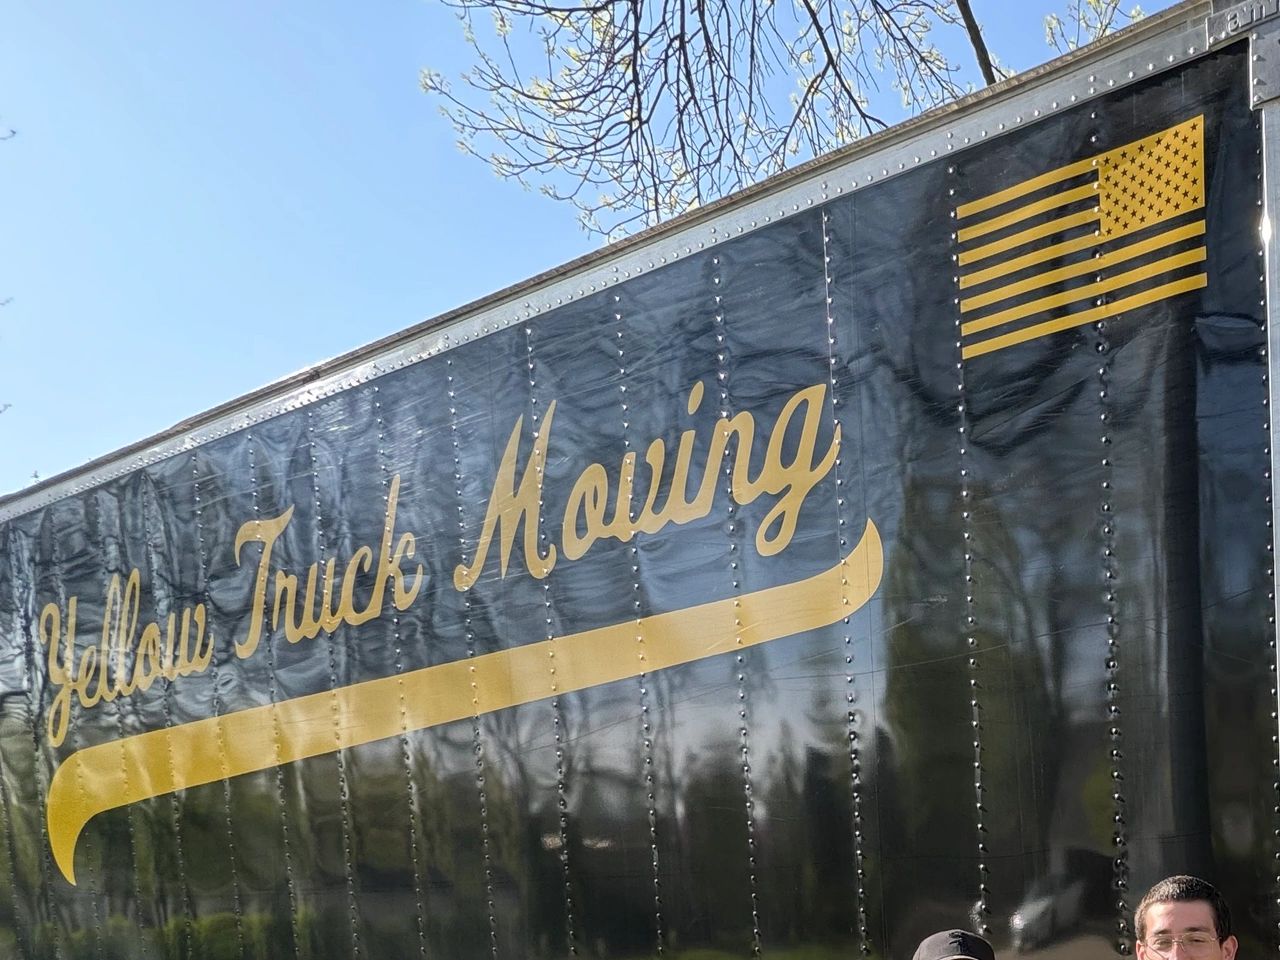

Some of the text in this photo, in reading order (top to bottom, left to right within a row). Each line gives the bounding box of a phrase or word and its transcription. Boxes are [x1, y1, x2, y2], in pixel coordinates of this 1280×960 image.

[40, 380, 842, 747] Yellow Truck Moving
